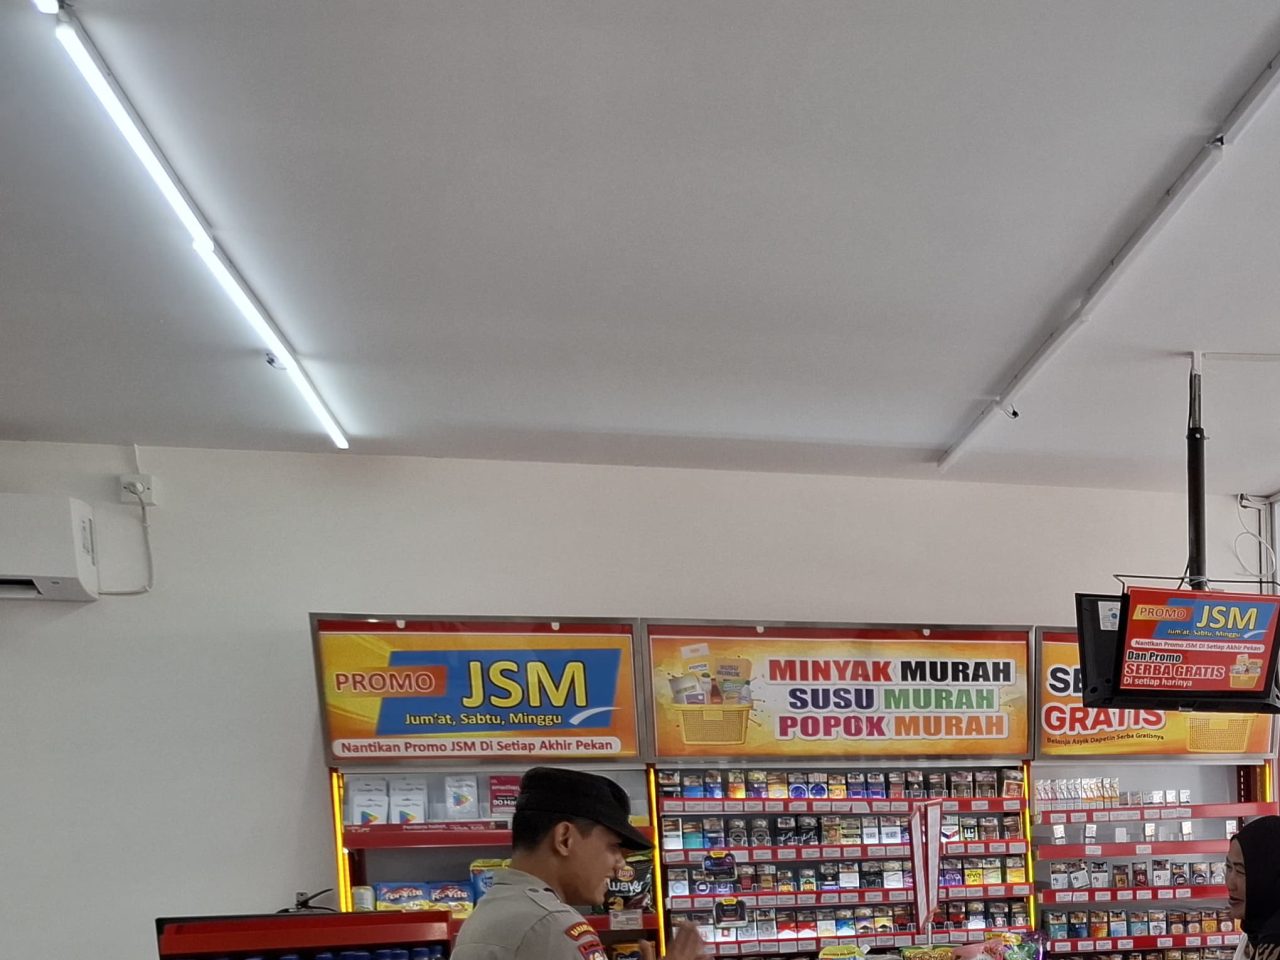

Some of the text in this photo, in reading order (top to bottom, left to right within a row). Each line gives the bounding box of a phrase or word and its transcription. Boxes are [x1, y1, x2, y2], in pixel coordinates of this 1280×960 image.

[1139, 605, 1258, 629] PROMO JSM
[1127, 651, 1180, 662] Dan Promo
[768, 659, 1012, 683] MINYAK MURAH
[1125, 663, 1225, 678] SERBA GRATIS
[334, 660, 588, 709] PROMO JSM
[1134, 678, 1160, 686] setiap
[1161, 678, 1193, 687] harinya
[788, 688, 996, 710] SUSU MURAH
[405, 712, 562, 726] Jum'at, Sabtu, Minggu
[779, 715, 1004, 737] POPOK MURAH
[1135, 732, 1164, 741] Gratisnya
[341, 739, 613, 754] Nantikan Promo JSM Di Setiap Akhir Pekan
